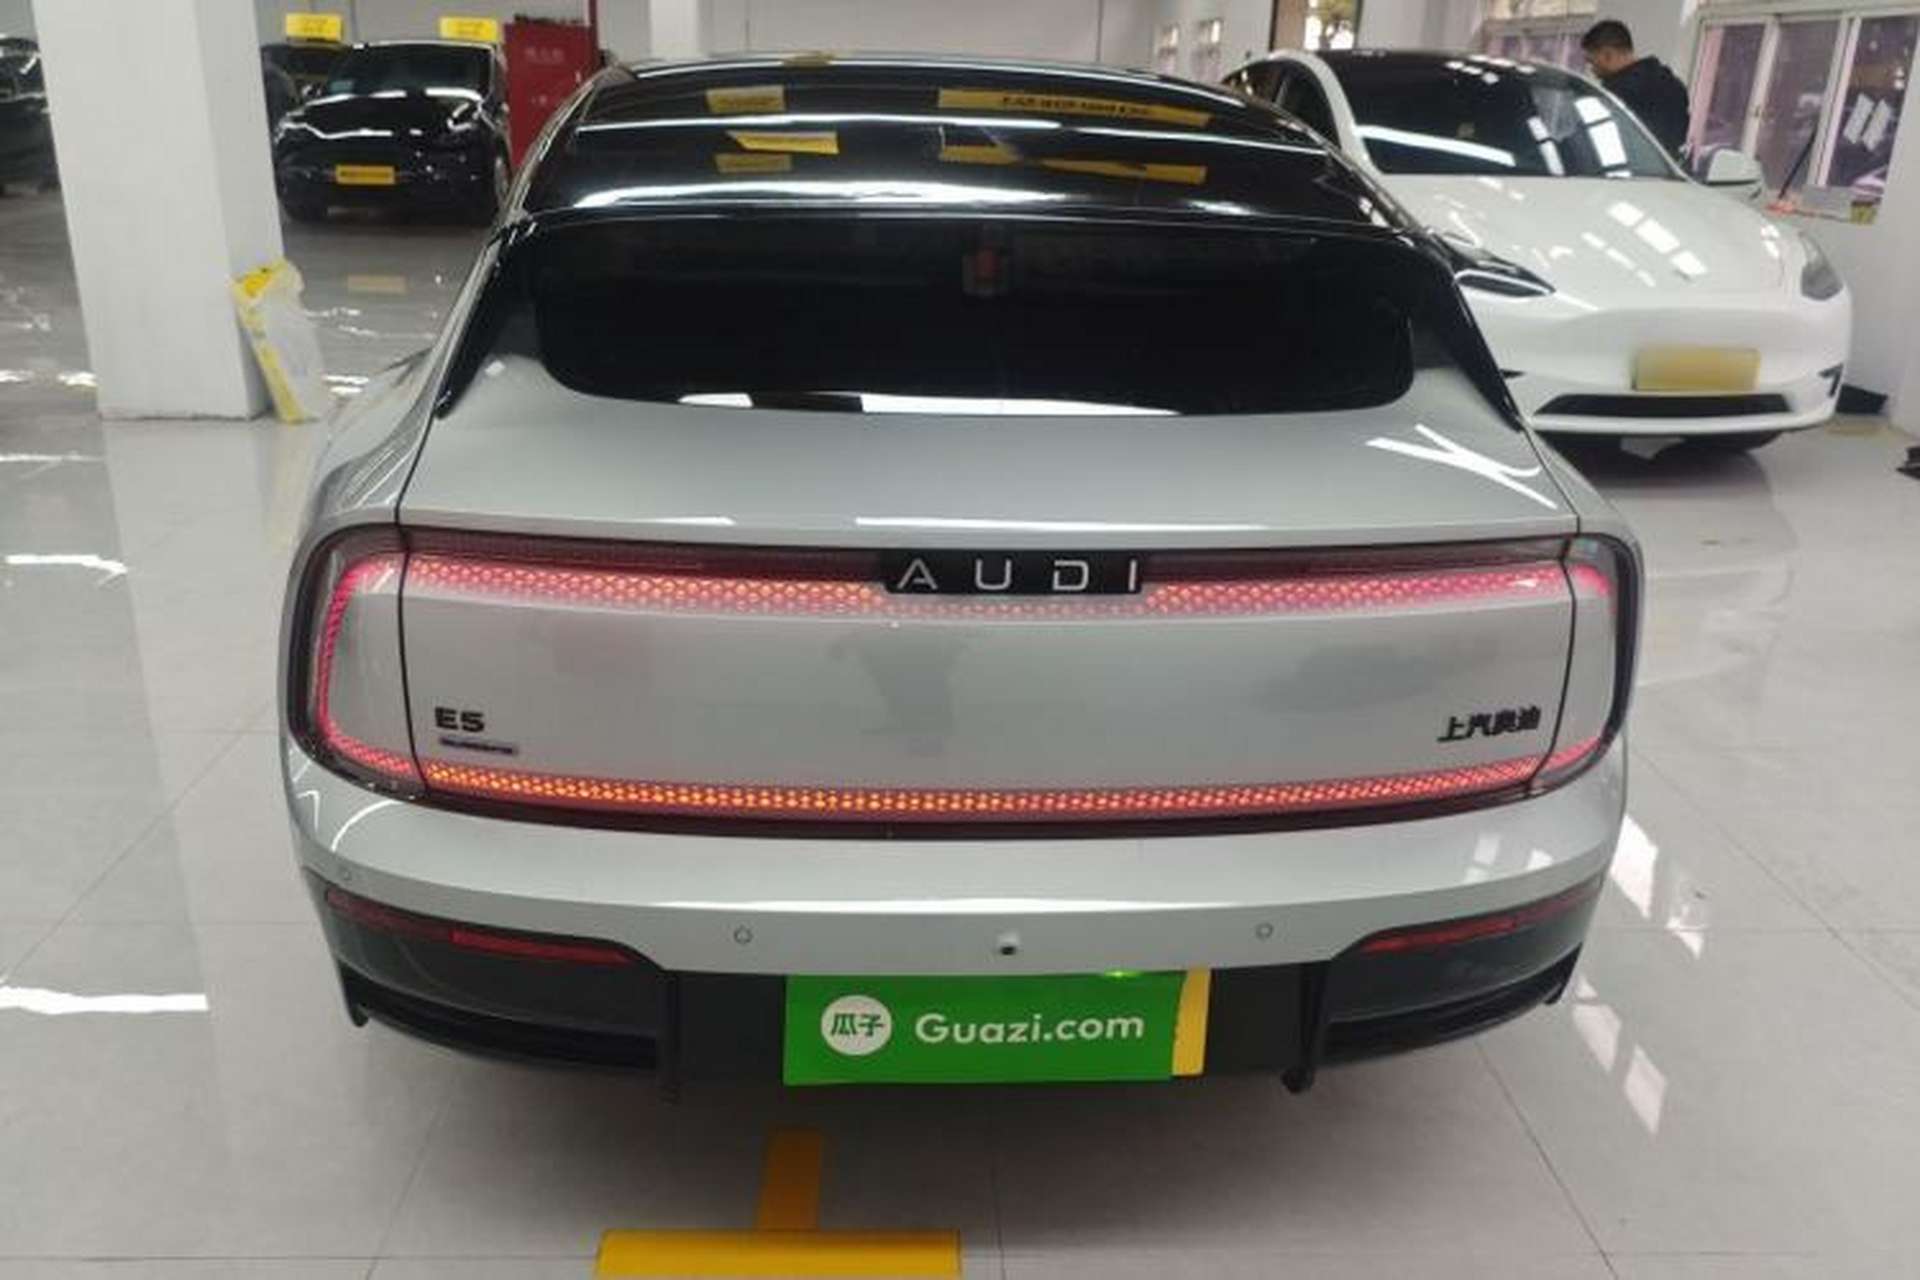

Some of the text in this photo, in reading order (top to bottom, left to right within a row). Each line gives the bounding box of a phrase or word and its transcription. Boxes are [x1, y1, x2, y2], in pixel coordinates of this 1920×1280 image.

[896, 558, 1137, 591] AUDI
[434, 707, 485, 732] E5
[830, 1012, 885, 1037] 瓜子
[914, 1012, 1145, 1043] Guazi.com
